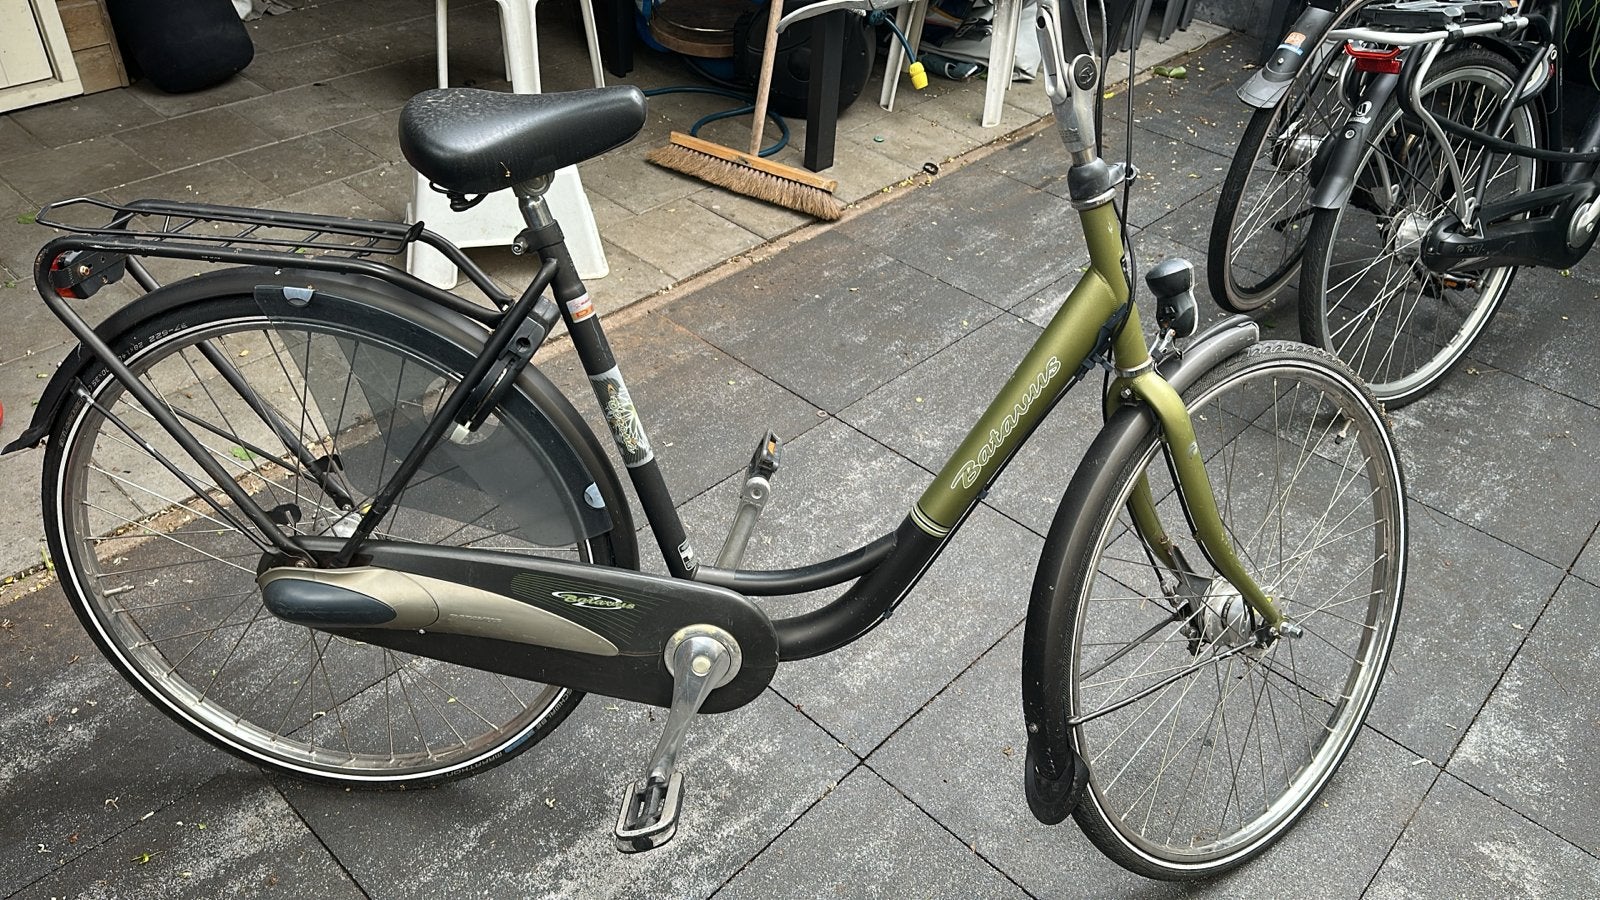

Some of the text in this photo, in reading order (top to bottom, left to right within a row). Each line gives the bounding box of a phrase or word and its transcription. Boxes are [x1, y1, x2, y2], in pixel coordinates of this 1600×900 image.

[148, 322, 189, 343] 37-622
[950, 355, 1061, 490] Batavus
[561, 593, 636, 610] Batavus
